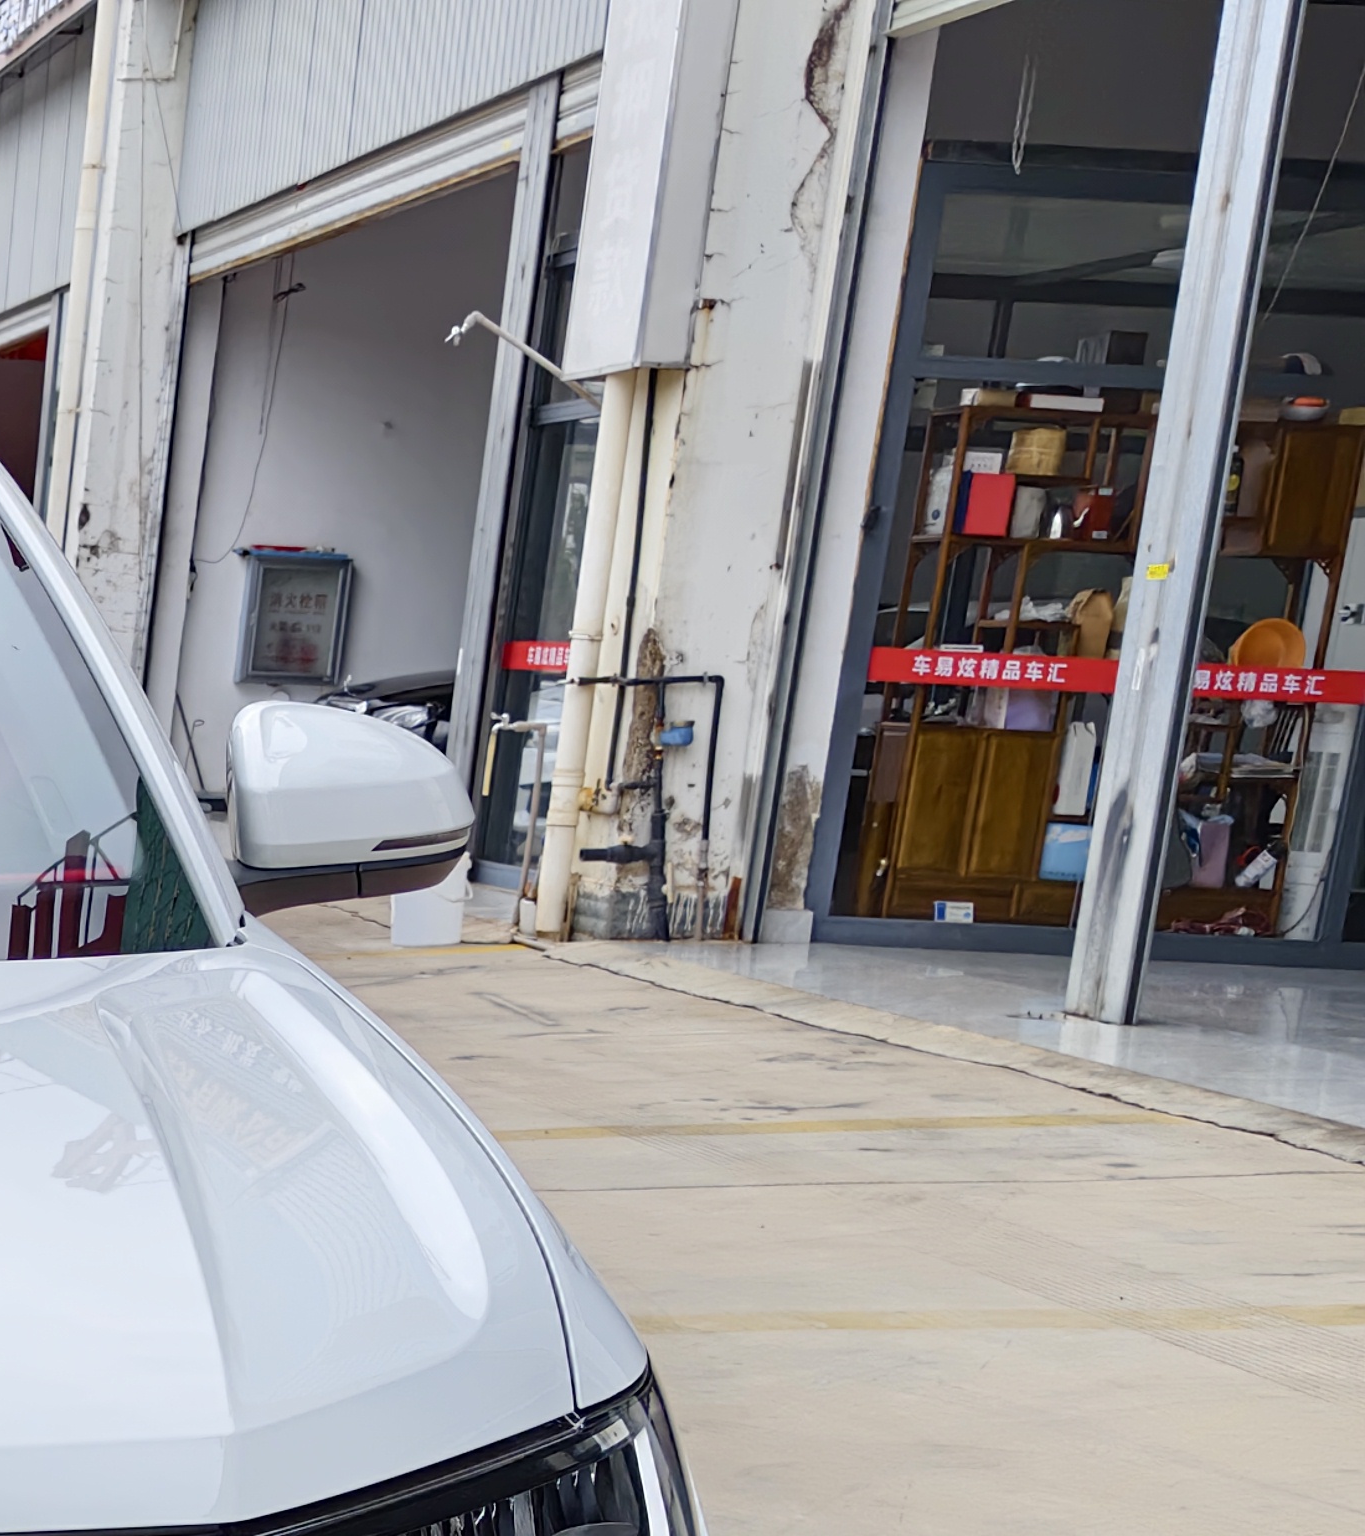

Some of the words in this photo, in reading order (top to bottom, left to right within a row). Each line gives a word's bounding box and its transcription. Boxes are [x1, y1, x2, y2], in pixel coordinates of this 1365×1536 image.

[911, 655, 1068, 684] 车易炫精品车汇
